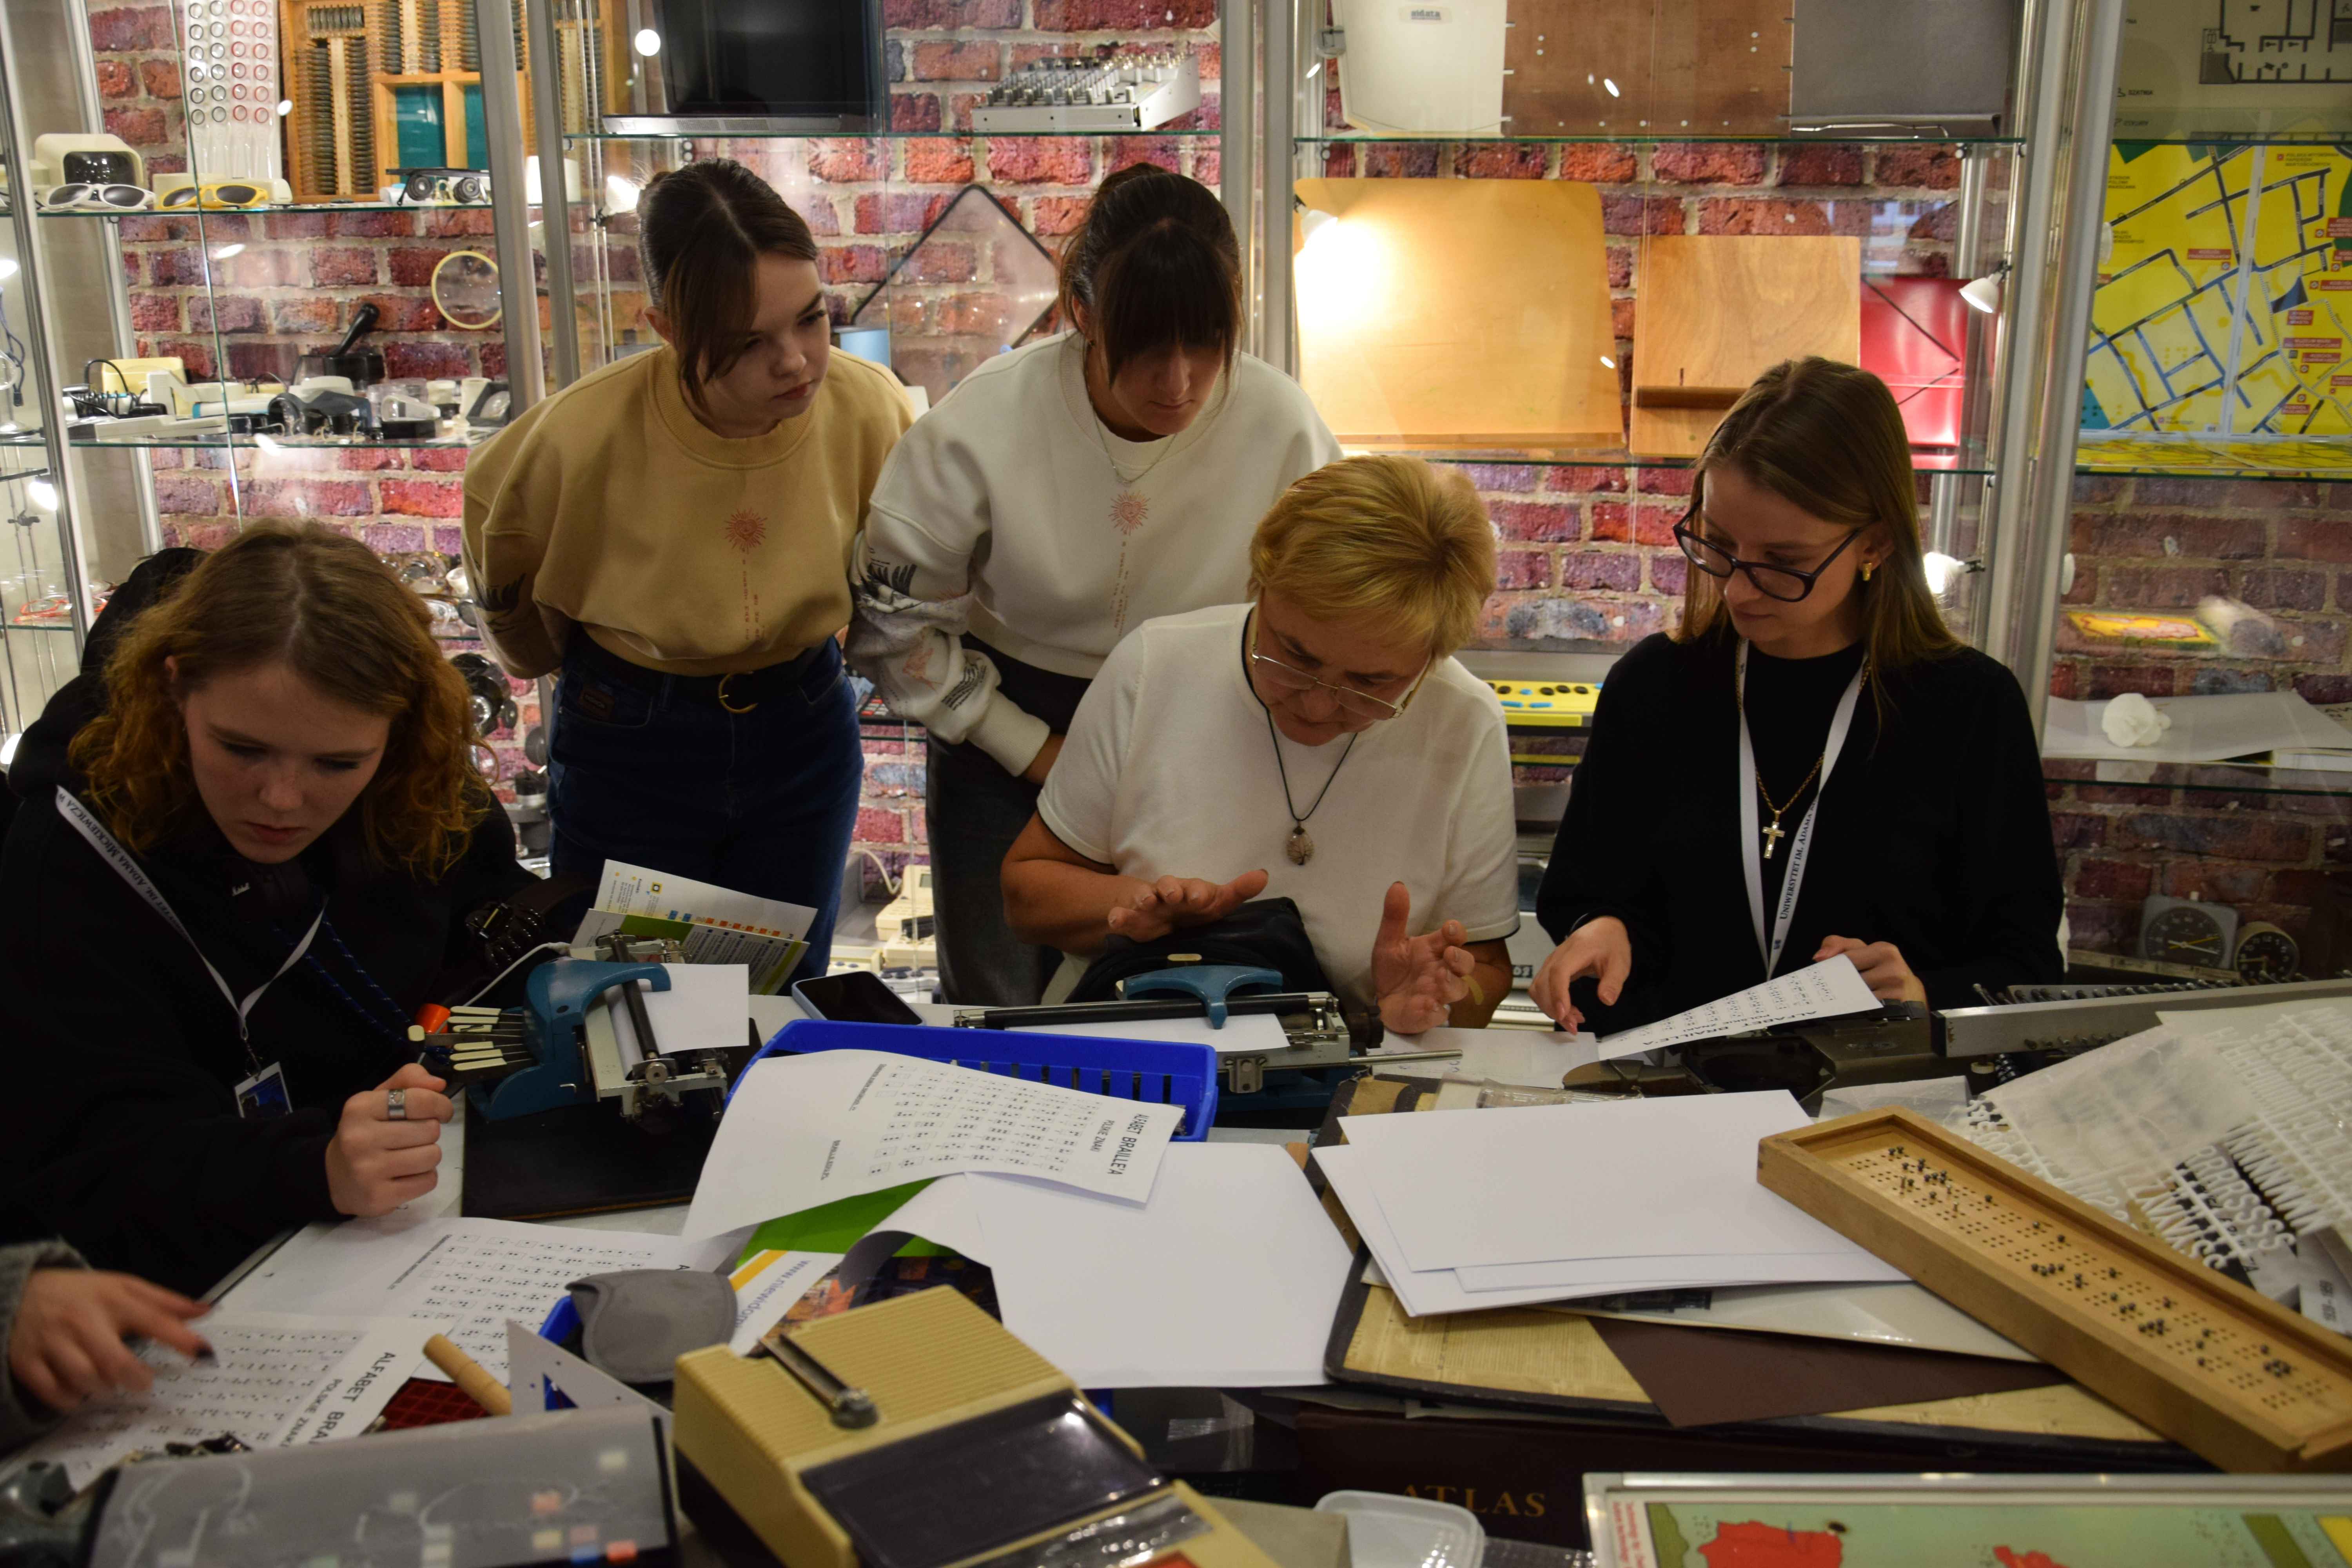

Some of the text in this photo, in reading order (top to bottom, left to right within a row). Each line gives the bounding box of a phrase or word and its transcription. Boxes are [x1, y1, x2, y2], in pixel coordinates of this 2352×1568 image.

[117, 855, 146, 886] ADAMA
[1780, 861, 1800, 920] UNIWERSYTET
[1643, 1011, 1817, 1045] ALFABET BRAILLE'A
[1107, 1113, 1149, 1175] ALFABET BRAILLE'A
[343, 1352, 396, 1402] ALFABET
[304, 1379, 343, 1413] POLSKIE
[1402, 1484, 1546, 1517] ATLAS
